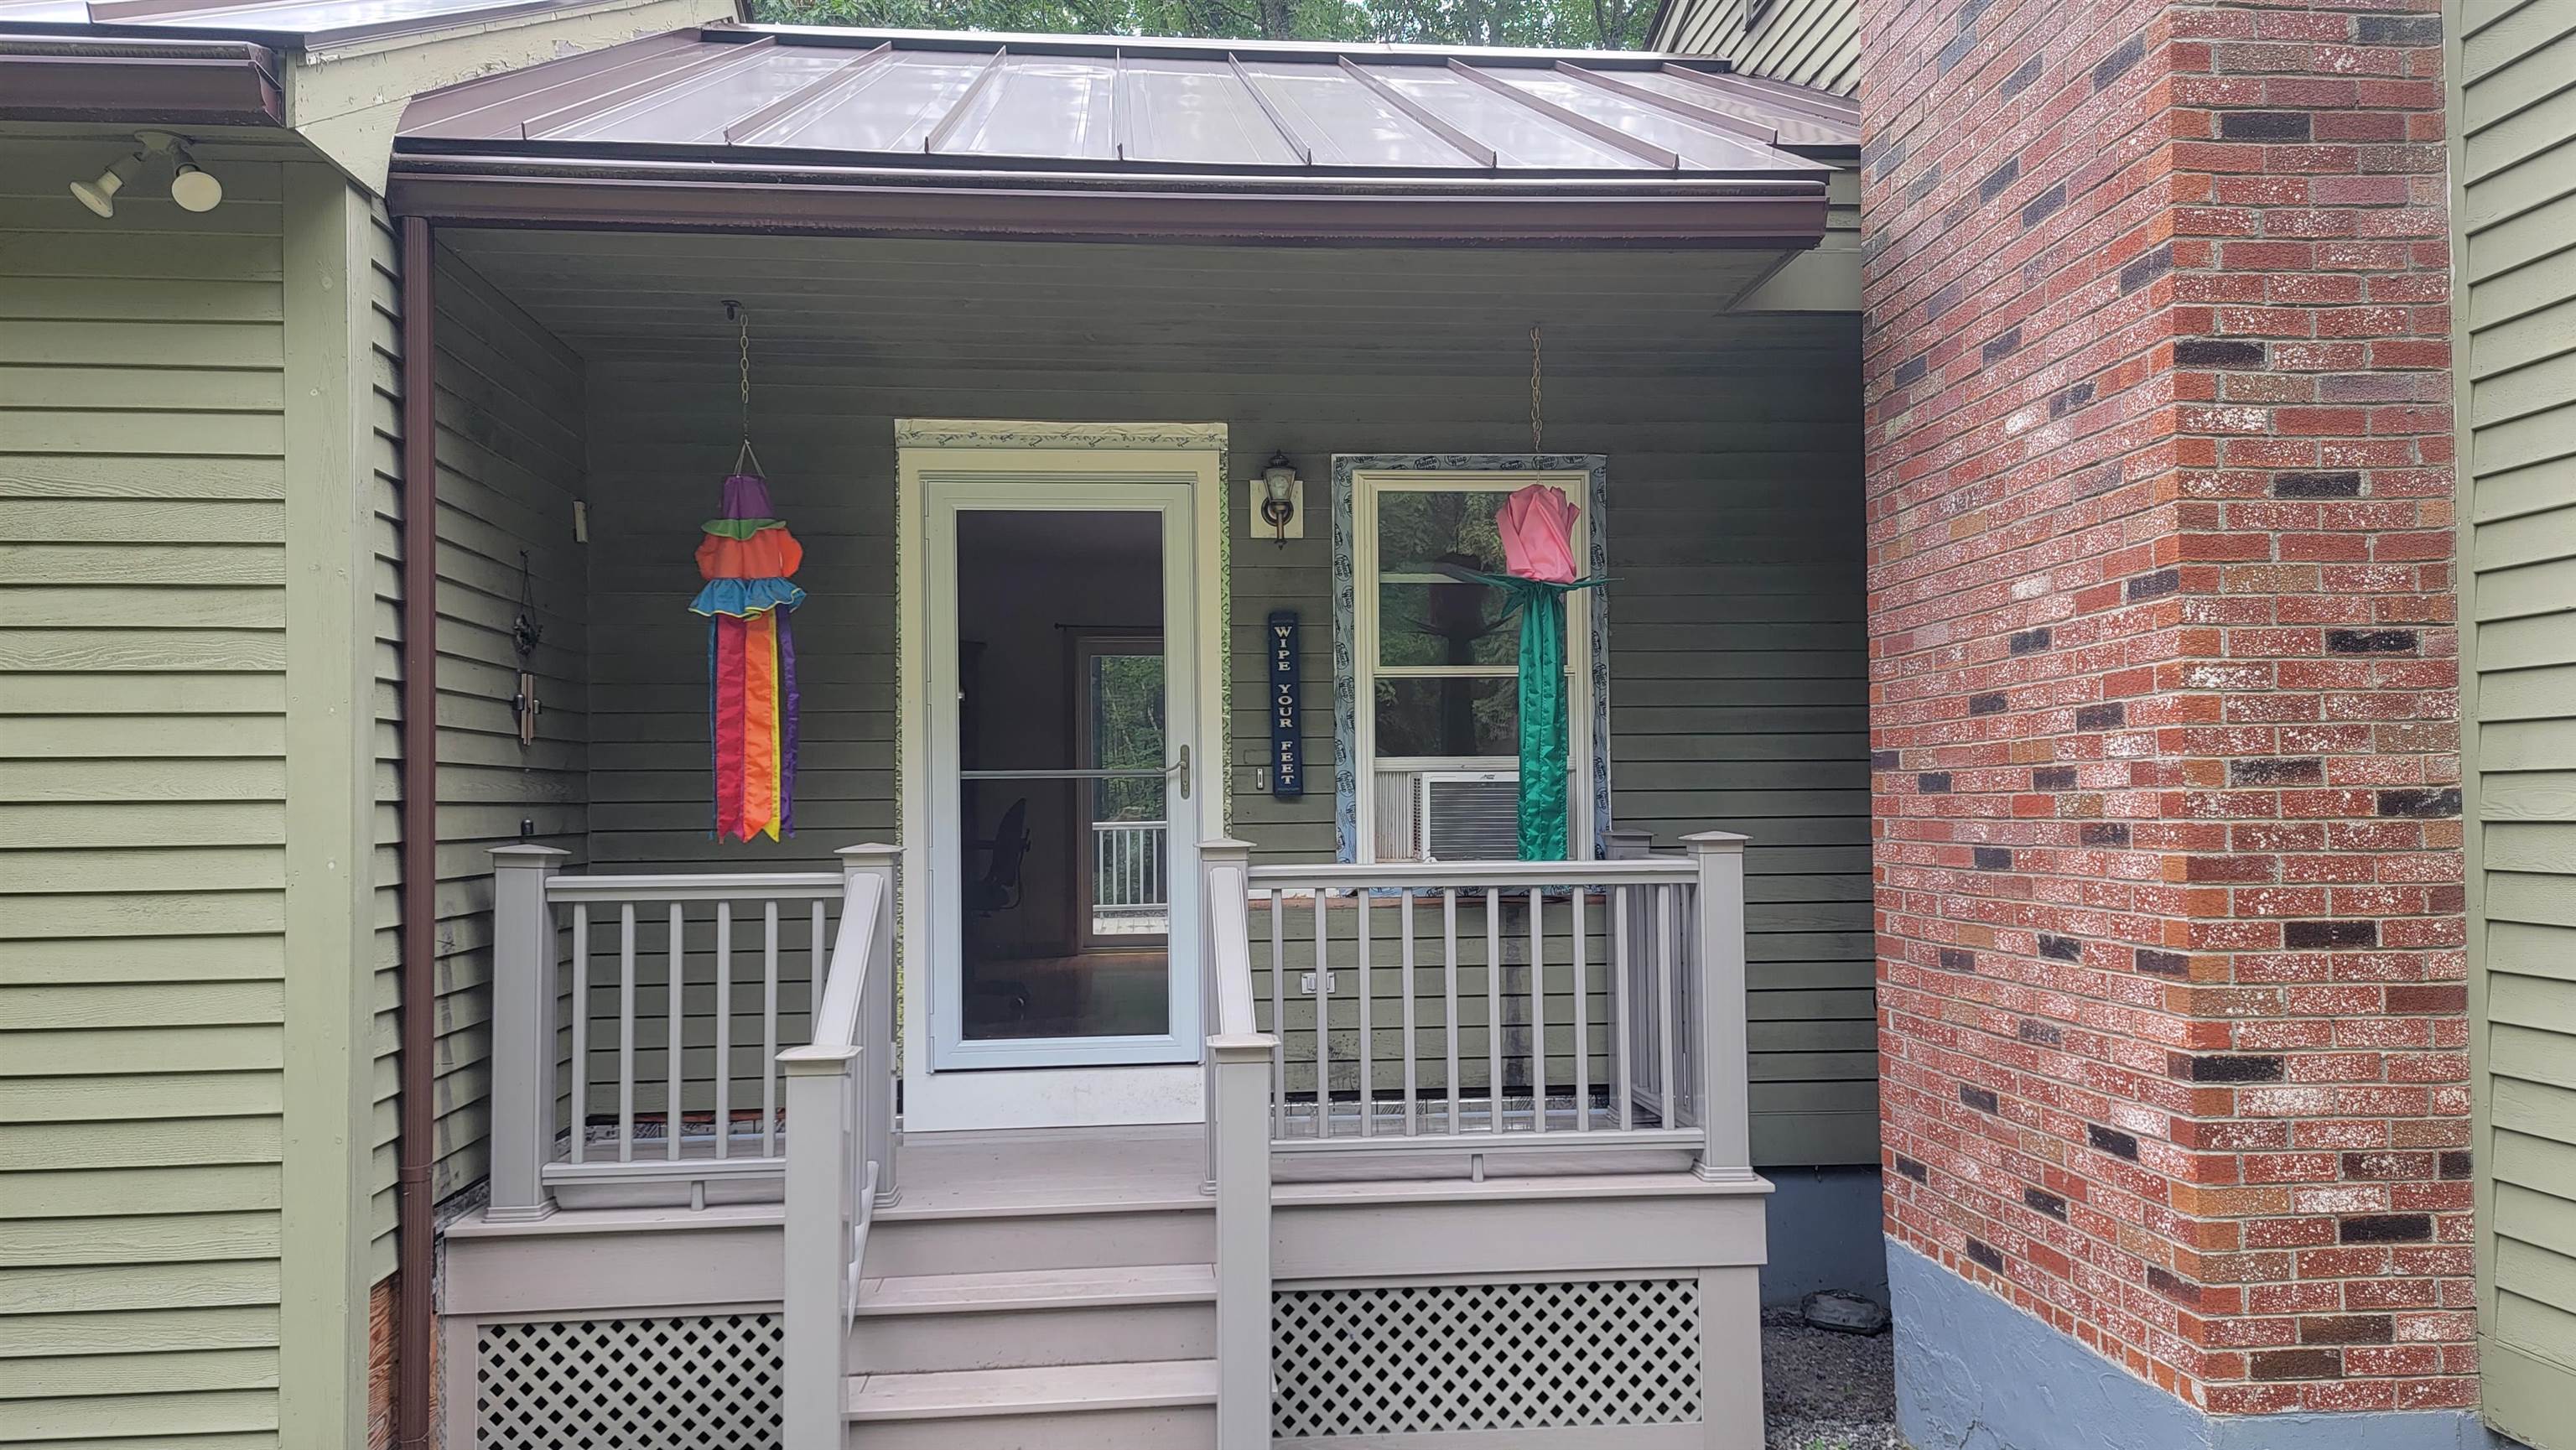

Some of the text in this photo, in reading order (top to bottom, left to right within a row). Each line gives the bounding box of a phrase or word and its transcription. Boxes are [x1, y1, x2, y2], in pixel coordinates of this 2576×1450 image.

[1342, 590, 1351, 609] Wrap
[1275, 626, 1295, 785] WIPE YOUR FEET
